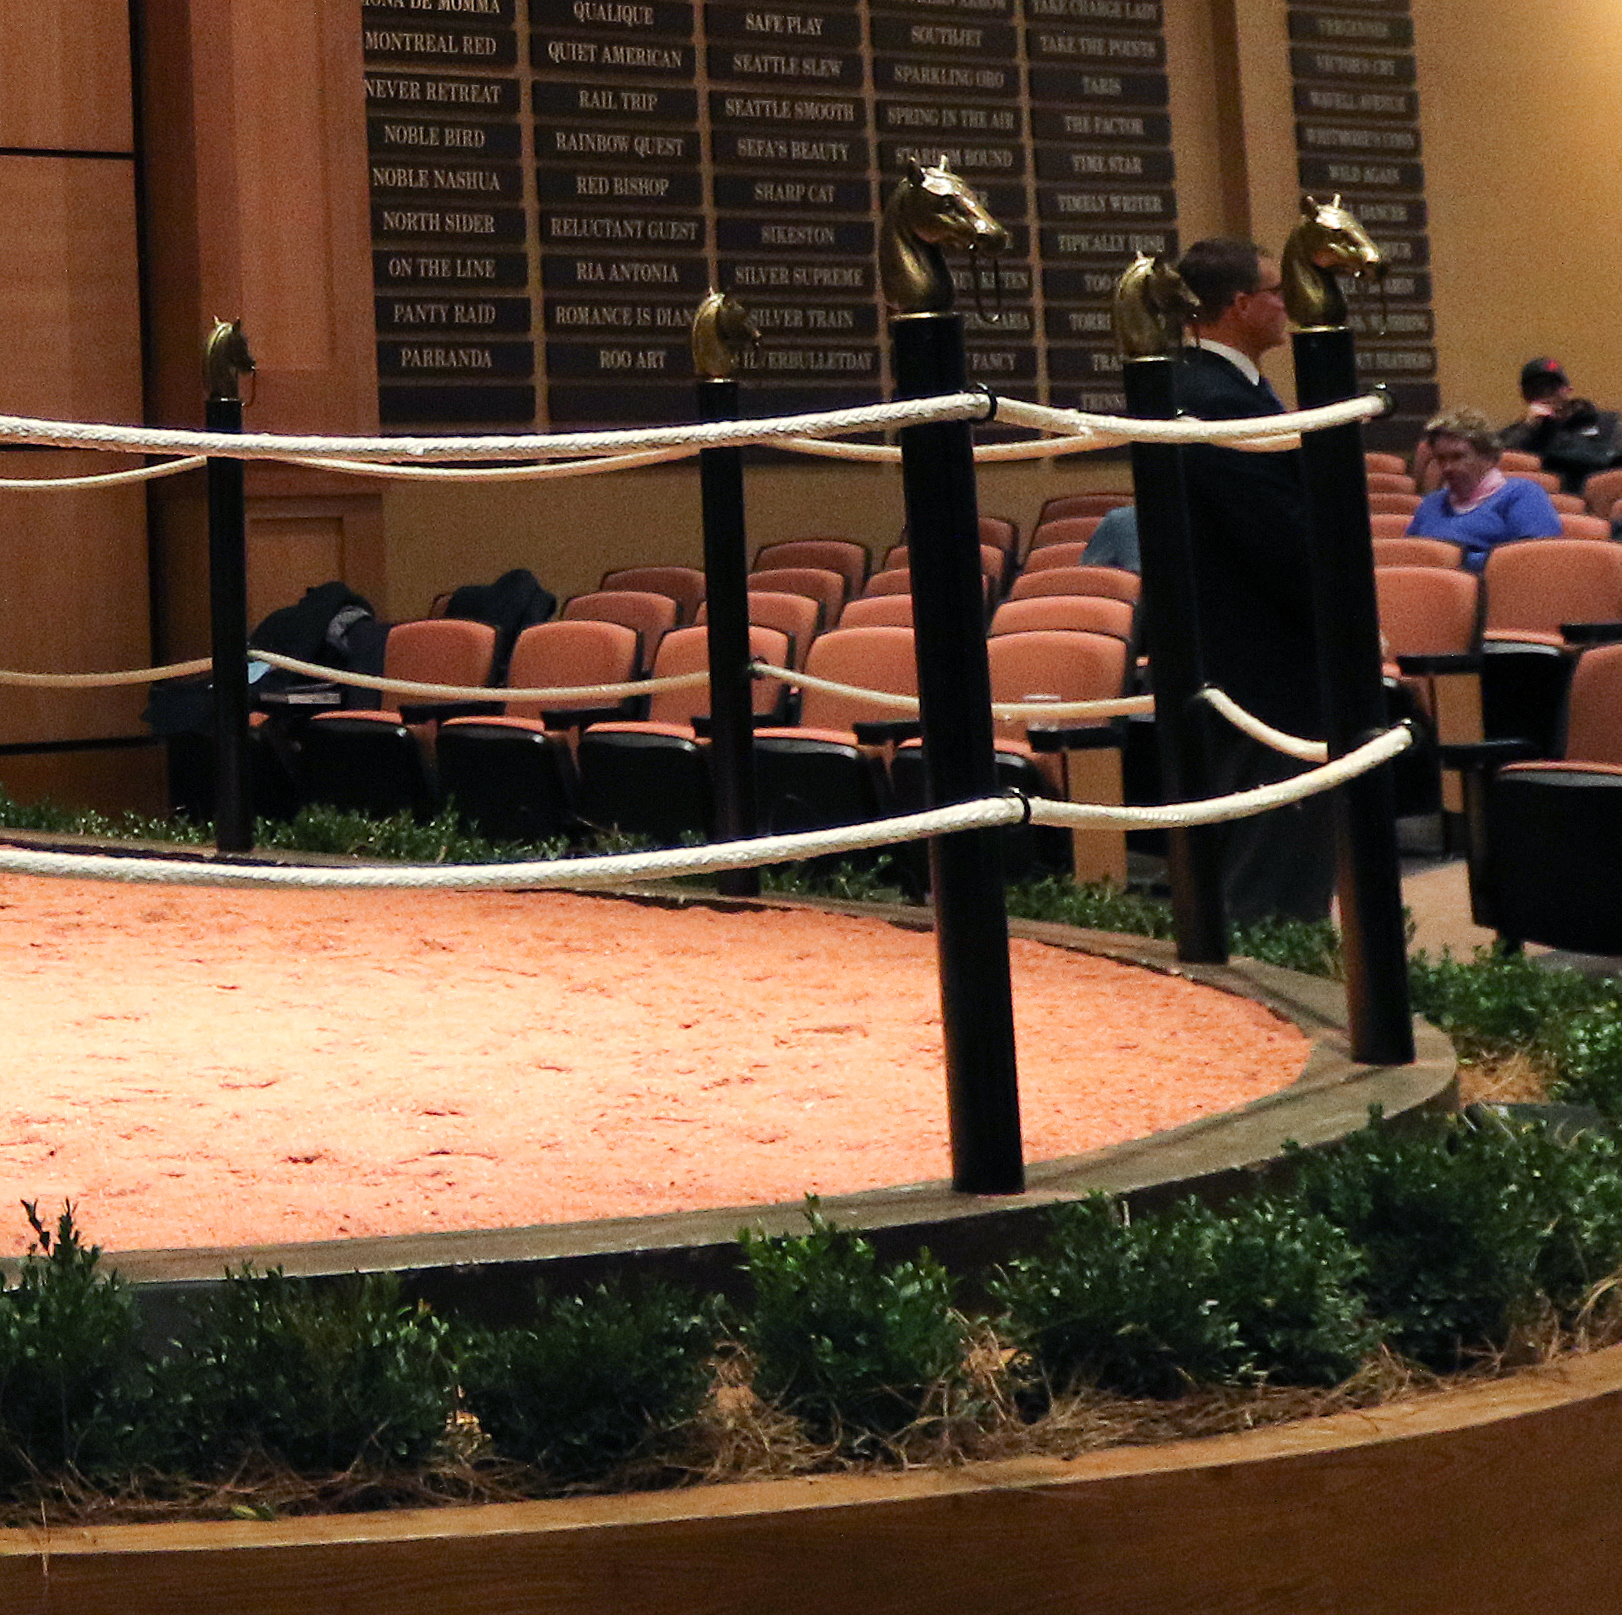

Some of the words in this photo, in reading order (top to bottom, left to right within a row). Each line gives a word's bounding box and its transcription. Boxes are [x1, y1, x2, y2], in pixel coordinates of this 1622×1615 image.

[574, 1, 654, 27] QUALIQUE
[746, 13, 783, 32] SAFE
[787, 16, 824, 36] PLAY
[365, 30, 458, 53] MONTREAL
[463, 36, 496, 56] RED
[548, 41, 597, 64] QUIET
[602, 46, 682, 68] AMERICAN
[734, 53, 798, 75] SEATTLE
[803, 59, 842, 77] SLEW
[365, 78, 421, 100] NEVER
[426, 83, 502, 104] RETREAT
[579, 90, 617, 110] RAIL
[622, 92, 657, 111] TRIP
[725, 98, 792, 119] SEATTLE
[795, 101, 854, 122] SMOOTH
[888, 108, 938, 126] SPRING
[942, 110, 957, 126] IN
[961, 111, 988, 128] THE
[384, 125, 439, 146] NOBLE
[445, 129, 486, 148] BIRD
[556, 132, 629, 153] RAINBOW
[635, 138, 683, 158] QUEST
[737, 138, 788, 158] SEFA'S
[791, 140, 849, 162] BEAUTY
[373, 168, 428, 188] NOBLE
[434, 170, 501, 191] NASHUA
[576, 176, 609, 194] RED
[614, 178, 669, 196] BISHOP
[755, 185, 806, 201] SHARP
[808, 185, 836, 203] CAT
[384, 211, 441, 232] NORTH
[445, 214, 496, 234] SIDER
[551, 217, 643, 239] RELUCTANT
[761, 225, 834, 244] SIKESTON
[389, 258, 413, 277] ON
[417, 259, 450, 277] THE
[457, 260, 496, 279] LINE
[576, 262, 603, 281] RIA
[610, 264, 679, 283] ANTONIA
[736, 266, 791, 284] SILVER
[795, 269, 862, 287] SUPREME
[982, 271, 1029, 289] KITEN
[393, 305, 448, 324] PANTY
[455, 305, 496, 324] RAID
[556, 305, 632, 326] ROMANCE
[637, 307, 650, 325] IS
[657, 307, 695, 327] DIAN
[808, 310, 853, 328] TRAIN
[401, 349, 493, 369] PARRANDA
[600, 350, 632, 368] ROO
[636, 351, 666, 369] ART
[735, 350, 872, 371] ILERBULLETDAY
